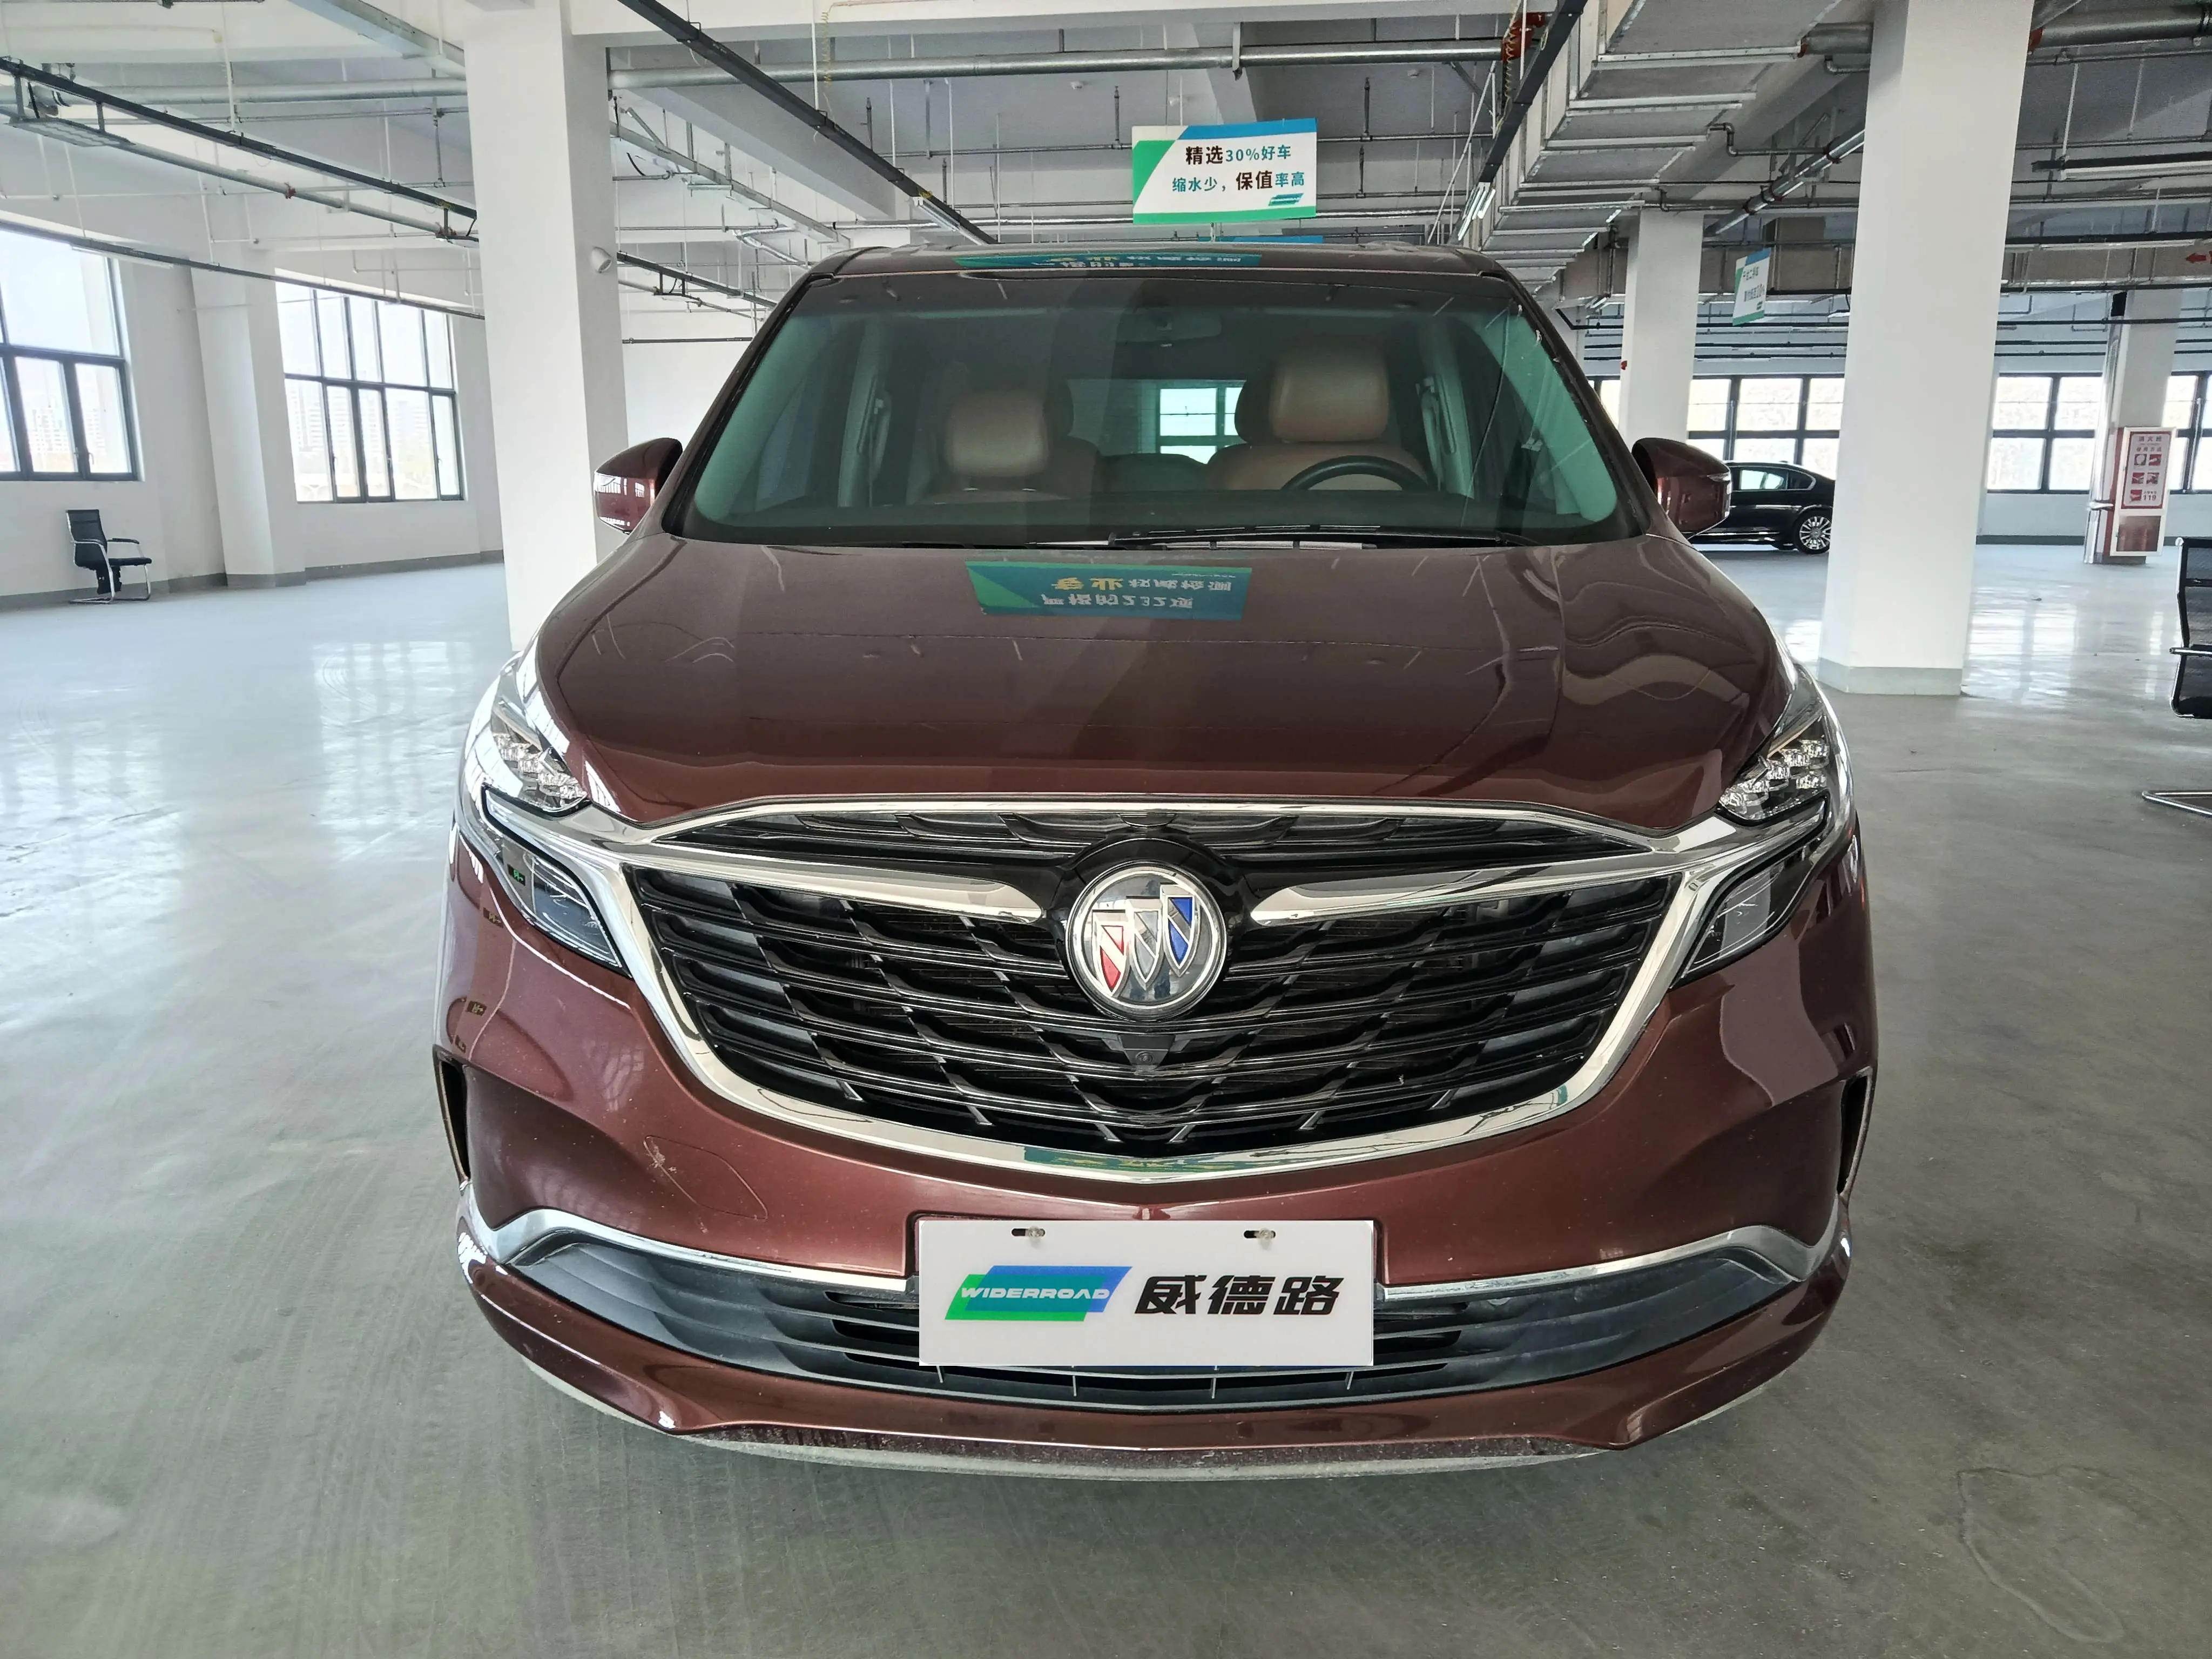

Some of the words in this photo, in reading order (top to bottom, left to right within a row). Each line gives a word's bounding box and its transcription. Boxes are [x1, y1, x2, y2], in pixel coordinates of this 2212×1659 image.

[1185, 145, 1291, 165] 精选30%好车
[1172, 171, 1305, 192] 缩水少，保值率高
[961, 1287, 1110, 1300] WIDERROAD
[1134, 1275, 1345, 1315] 威德路
